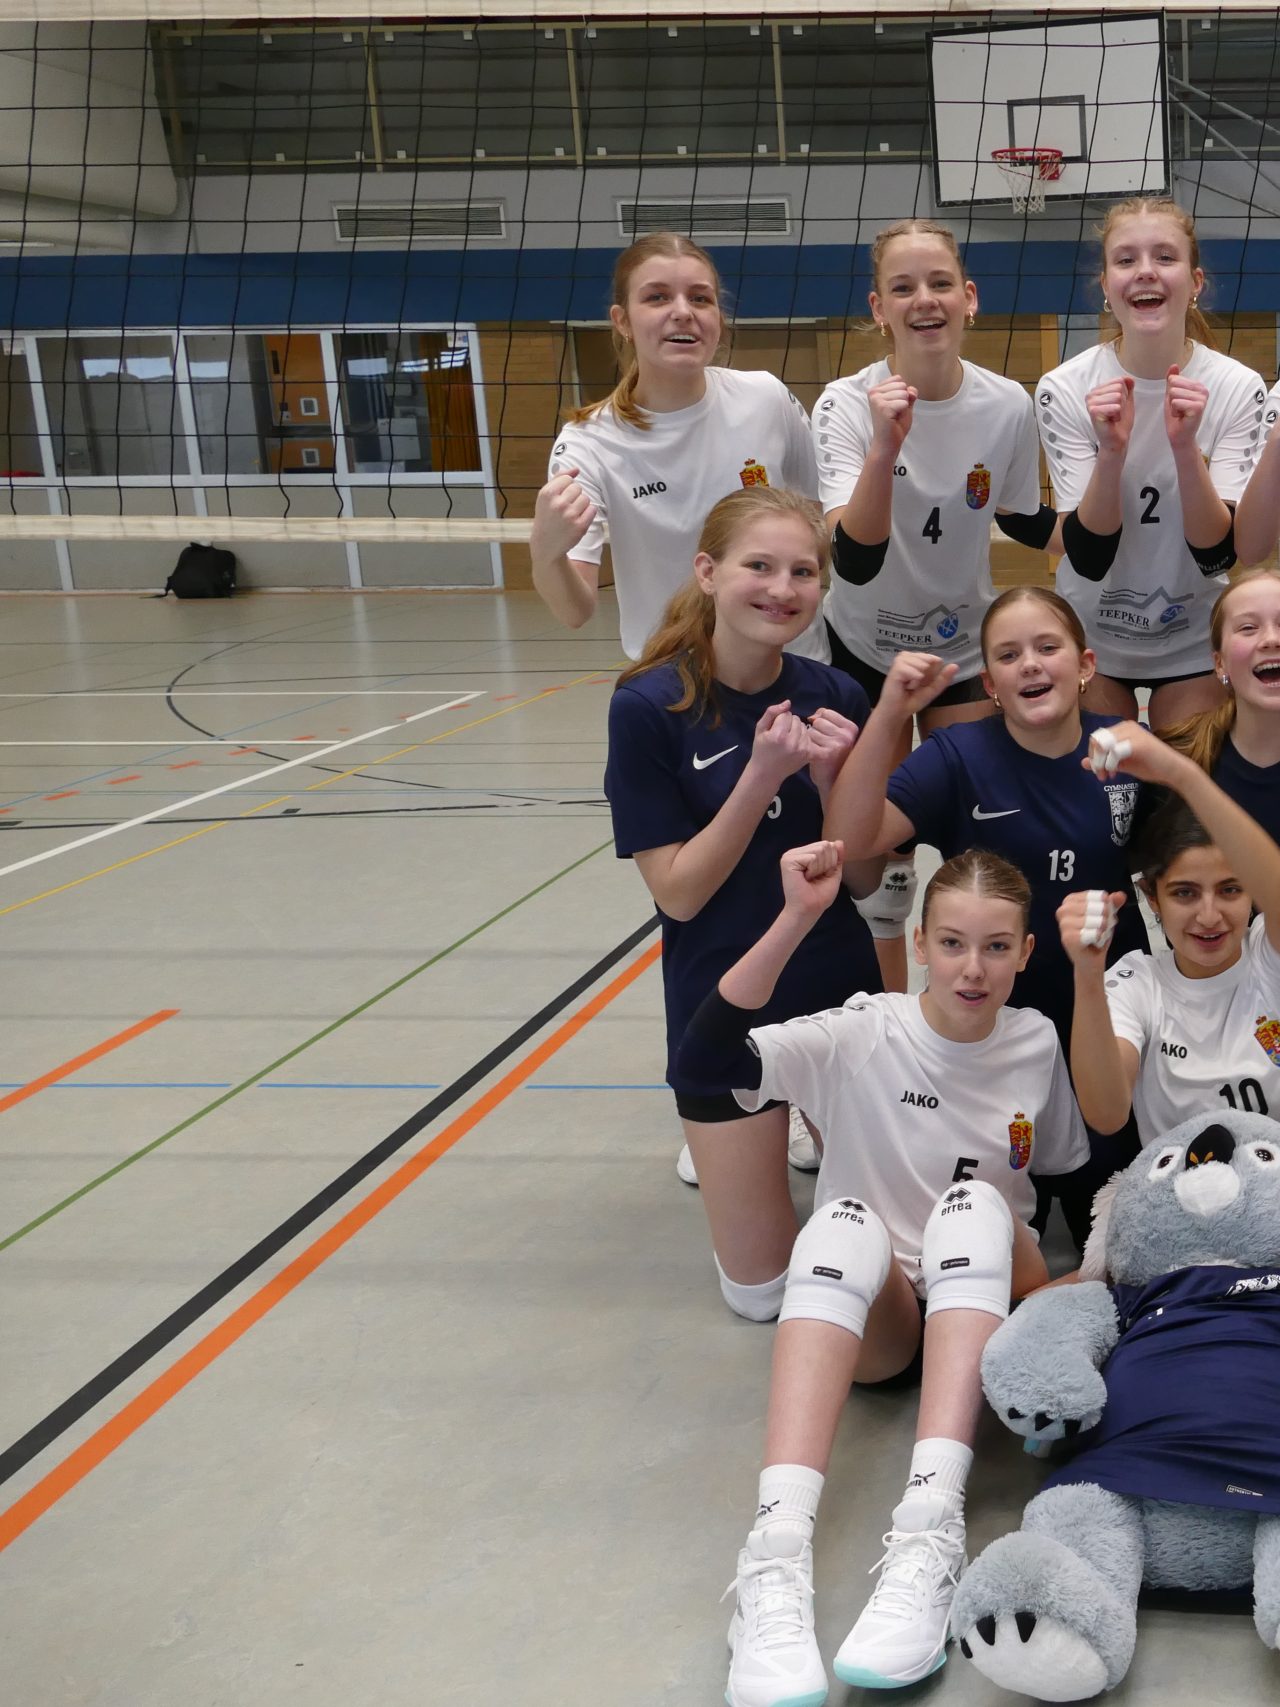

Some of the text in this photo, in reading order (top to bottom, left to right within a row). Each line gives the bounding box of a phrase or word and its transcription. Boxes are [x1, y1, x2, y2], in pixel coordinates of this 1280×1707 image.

[632, 481, 668, 499] JAKO
[1139, 486, 1160, 525] 2
[922, 506, 943, 545] 4
[1097, 608, 1150, 628] TEEPKER
[876, 627, 932, 643] TEEPKER
[1048, 849, 1076, 882] 13
[1160, 1042, 1188, 1059] AKO
[900, 1090, 940, 1110] JAKO
[1218, 1077, 1269, 1116] 10
[951, 1156, 979, 1183] 5
[831, 1210, 865, 1226] errea
[940, 1201, 973, 1217] errea
